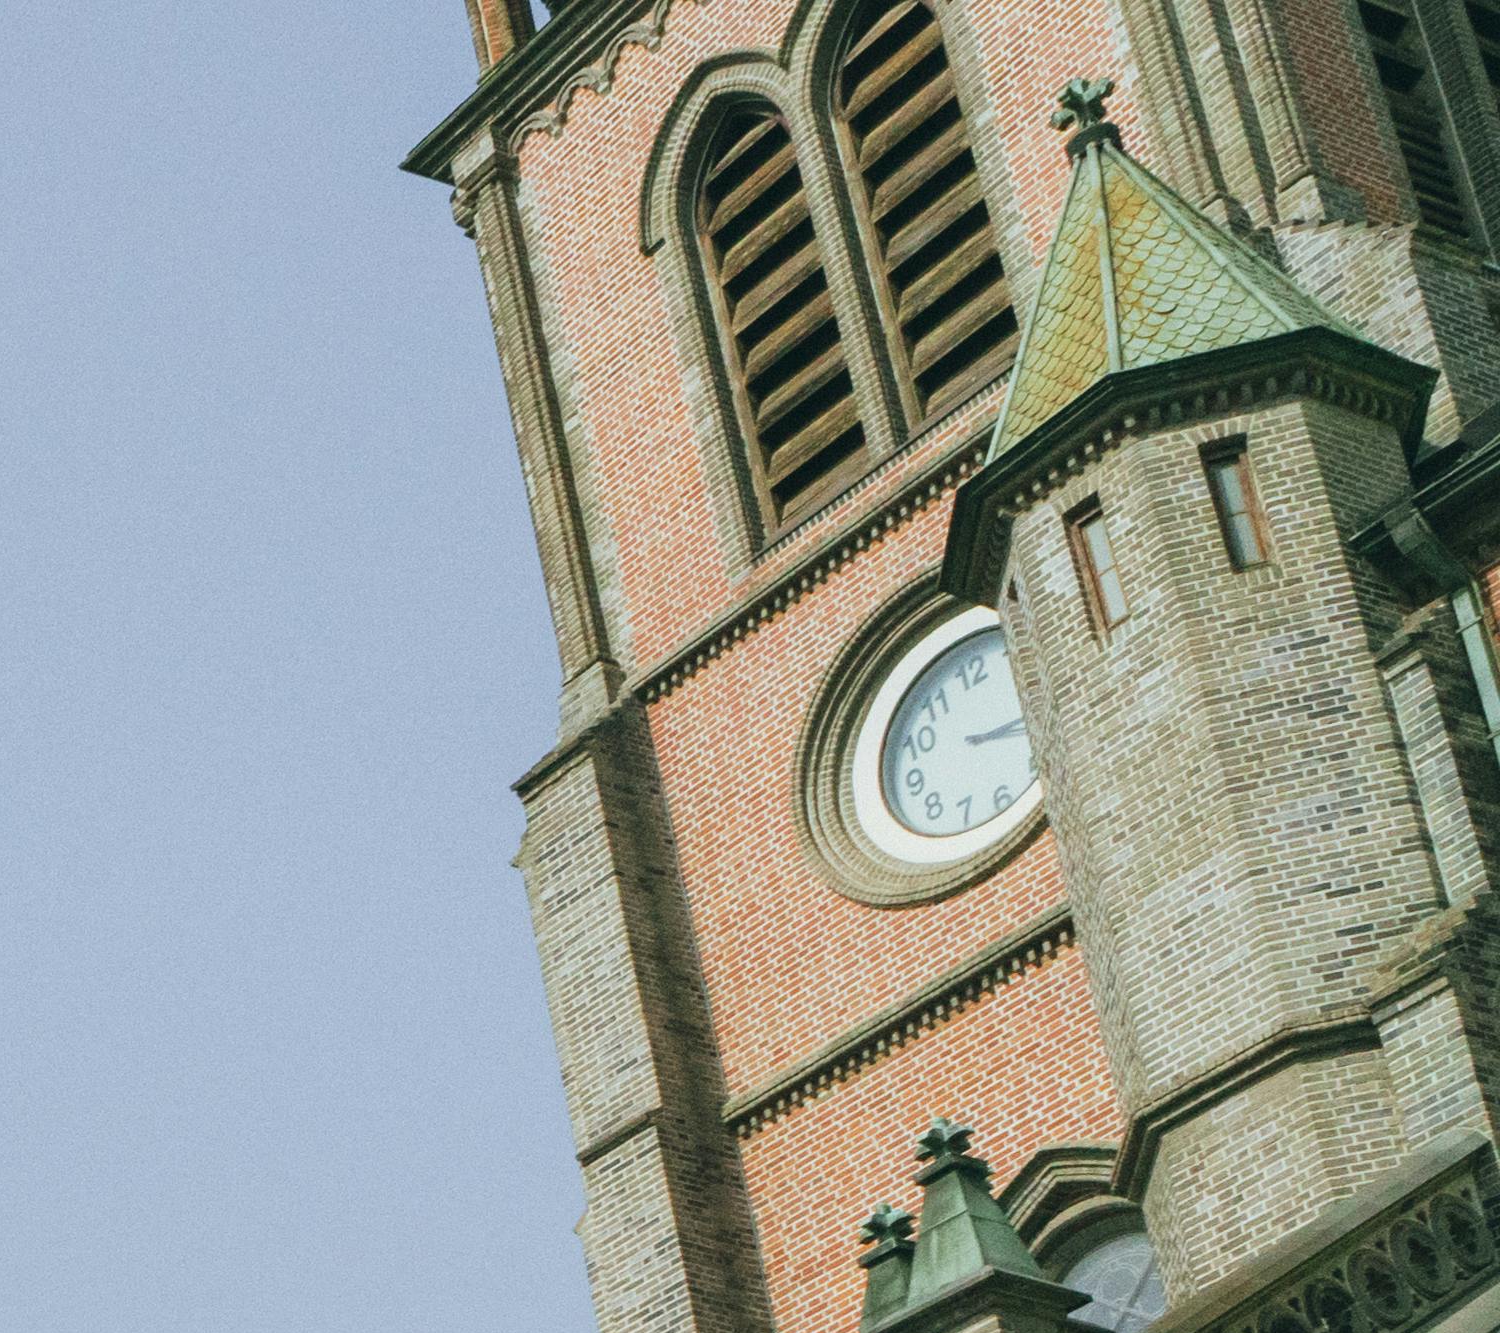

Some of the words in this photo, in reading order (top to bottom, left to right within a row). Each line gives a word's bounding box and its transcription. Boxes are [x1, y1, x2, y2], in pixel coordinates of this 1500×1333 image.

[955, 655, 989, 691] 12
[920, 687, 949, 723] 11
[902, 725, 935, 761] 10
[906, 768, 924, 796] 9
[993, 784, 1012, 810] 6
[924, 791, 944, 820] 8
[956, 794, 973, 825] 7
